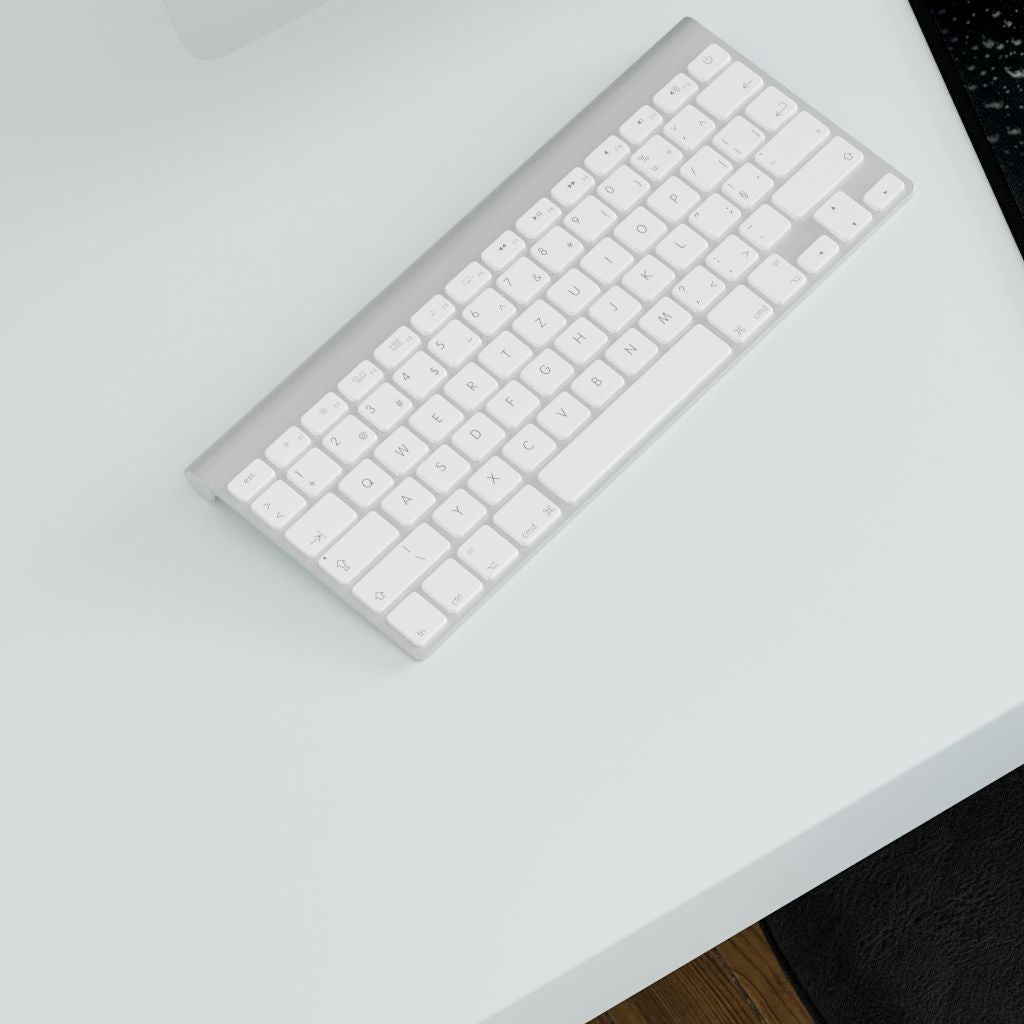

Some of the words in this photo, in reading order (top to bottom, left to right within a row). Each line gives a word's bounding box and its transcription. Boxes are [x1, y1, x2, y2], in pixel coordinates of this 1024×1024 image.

[668, 193, 679, 204] P
[570, 216, 581, 225] 9
[636, 223, 648, 235] O
[673, 241, 687, 250] L
[537, 247, 548, 256] 8
[639, 270, 654, 281] K
[502, 277, 513, 288] 7
[567, 284, 581, 297] U
[608, 301, 619, 312] J
[470, 309, 480, 319] 6
[657, 311, 673, 326] M
[534, 316, 548, 329] Z
[571, 331, 587, 345] H
[434, 340, 446, 351] 5
[623, 343, 638, 356] N
[499, 348, 512, 359] T
[539, 364, 552, 375] G
[401, 371, 412, 381] 4
[465, 380, 479, 392] R
[590, 376, 603, 388] B
[504, 396, 515, 408] F
[365, 404, 376, 415] 3
[555, 407, 568, 418] V
[431, 412, 444, 424] E
[468, 429, 482, 441] D
[329, 436, 342, 447] 2
[522, 440, 535, 451] C
[393, 443, 410, 457] W
[434, 461, 448, 472] S
[360, 478, 375, 489] Q
[486, 472, 501, 486] X
[400, 495, 414, 507] A
[450, 504, 464, 516] Y
